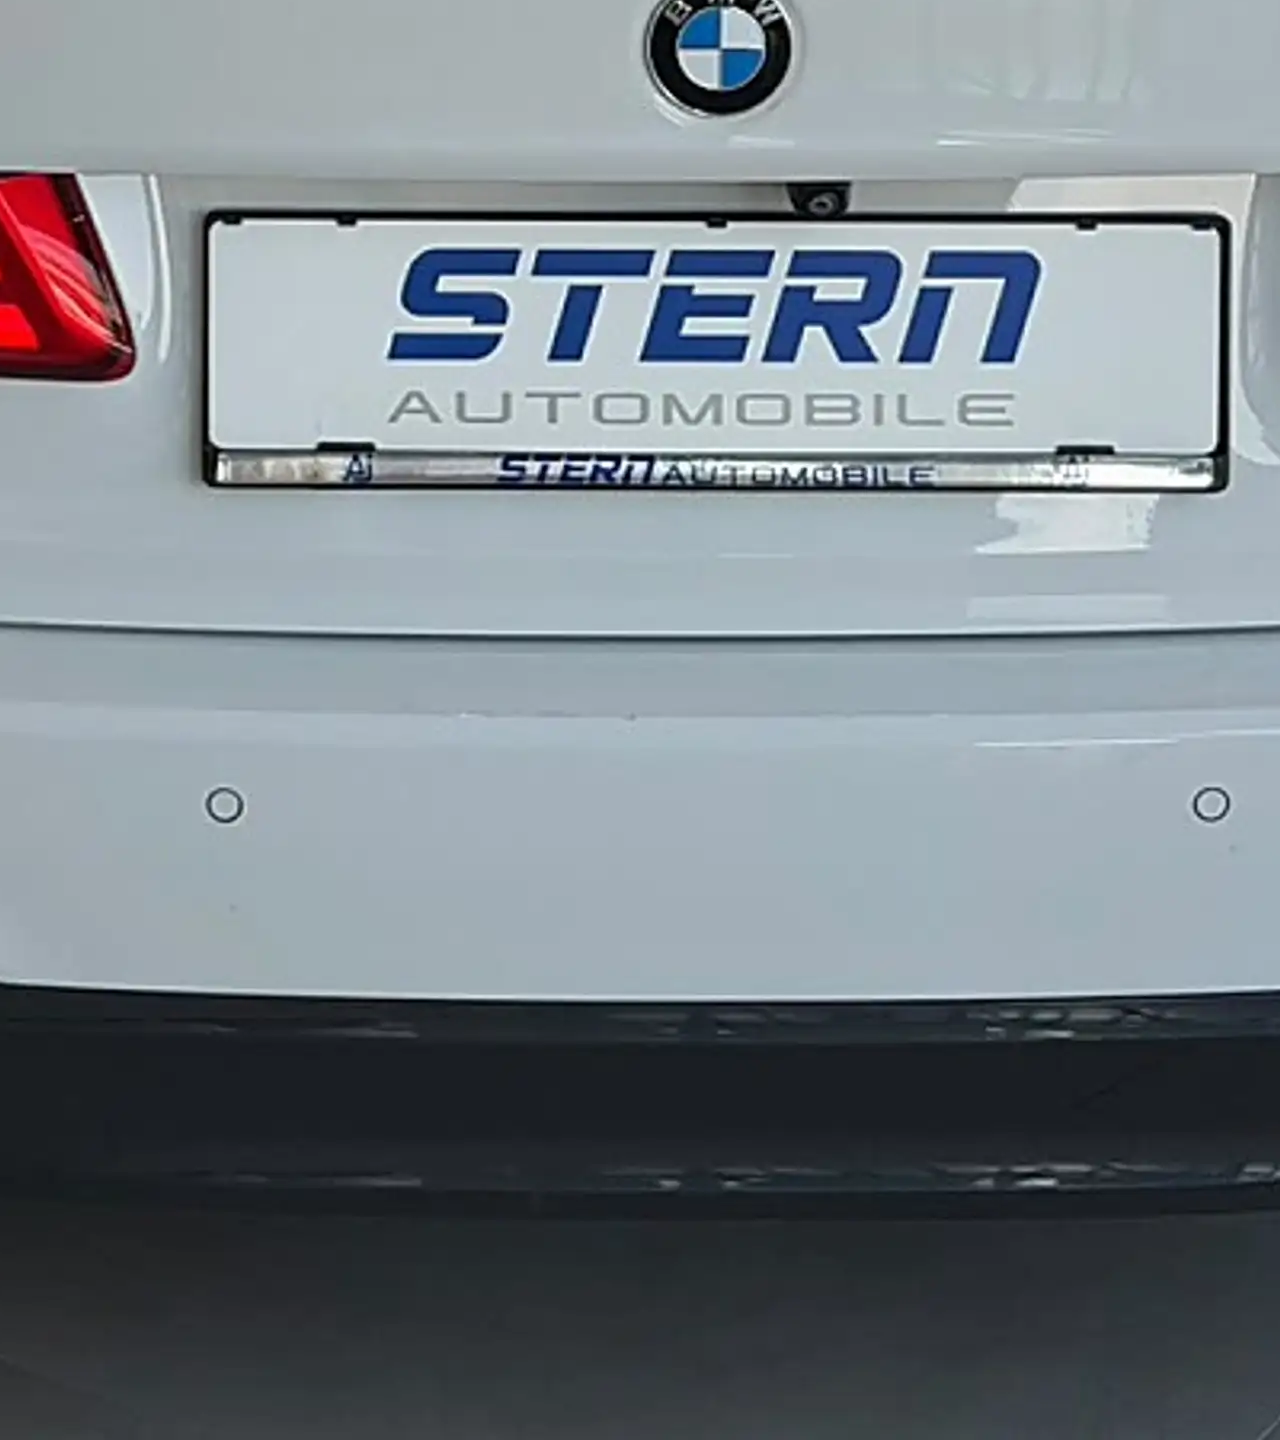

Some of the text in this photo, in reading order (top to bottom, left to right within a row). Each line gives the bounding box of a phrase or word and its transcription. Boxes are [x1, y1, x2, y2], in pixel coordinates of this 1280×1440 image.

[386, 248, 1043, 363] STERN
[387, 391, 1016, 427] AUTOMOBILE
[496, 454, 937, 487] STERN AUTOMOBILE
